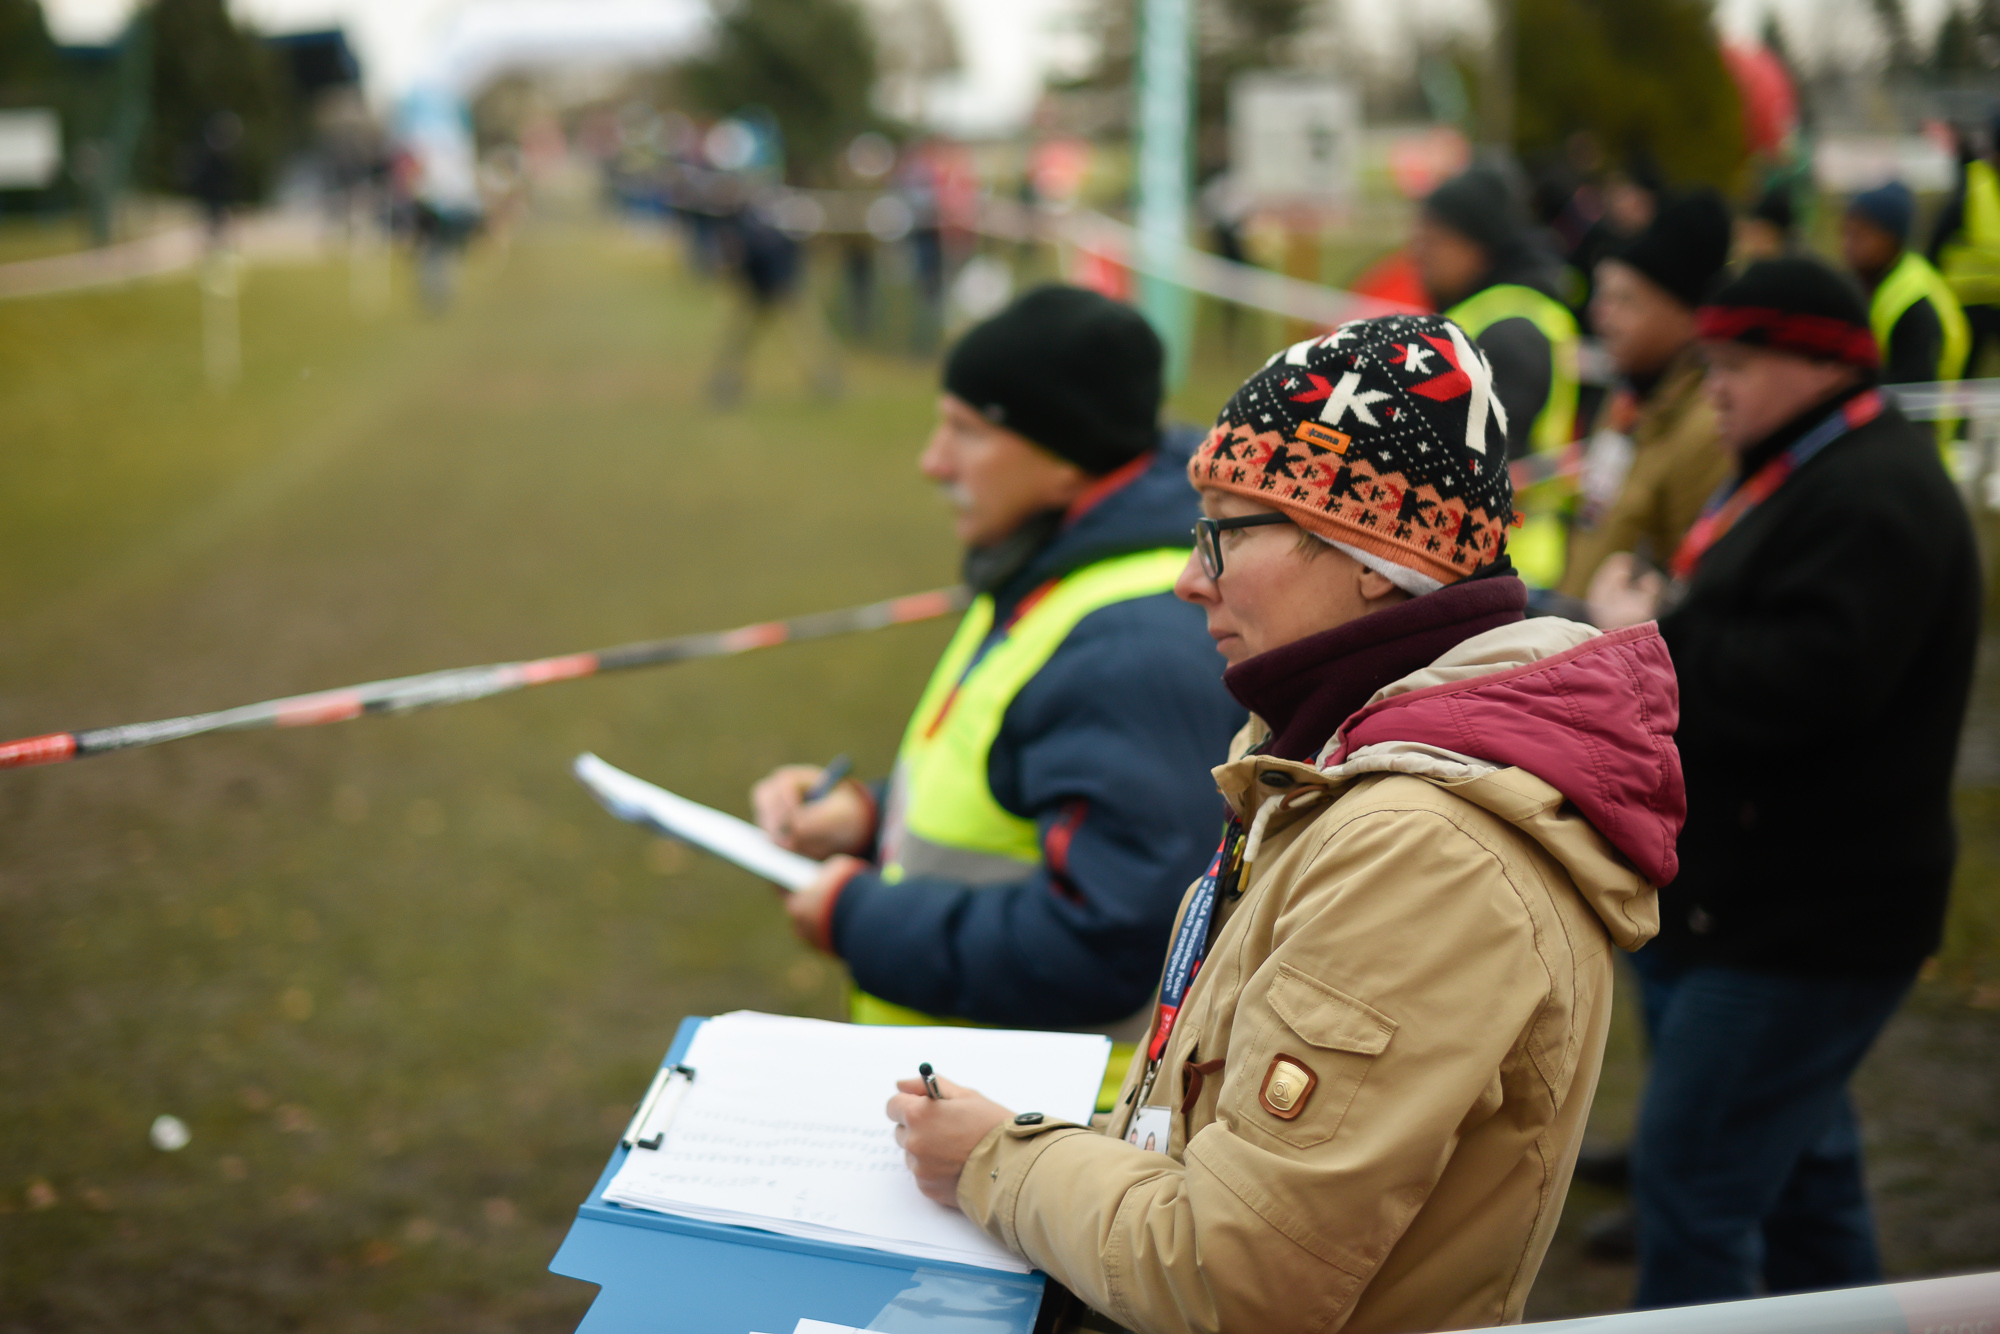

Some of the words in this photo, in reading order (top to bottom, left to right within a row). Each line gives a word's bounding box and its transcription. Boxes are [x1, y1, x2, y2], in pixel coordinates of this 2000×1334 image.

[1308, 427, 1340, 446] kama
[1185, 888, 1207, 927] biegach
[1198, 895, 1213, 916] PZLA
[1179, 917, 1204, 971] Mistrzostwa
[1171, 971, 1185, 999] Polski
